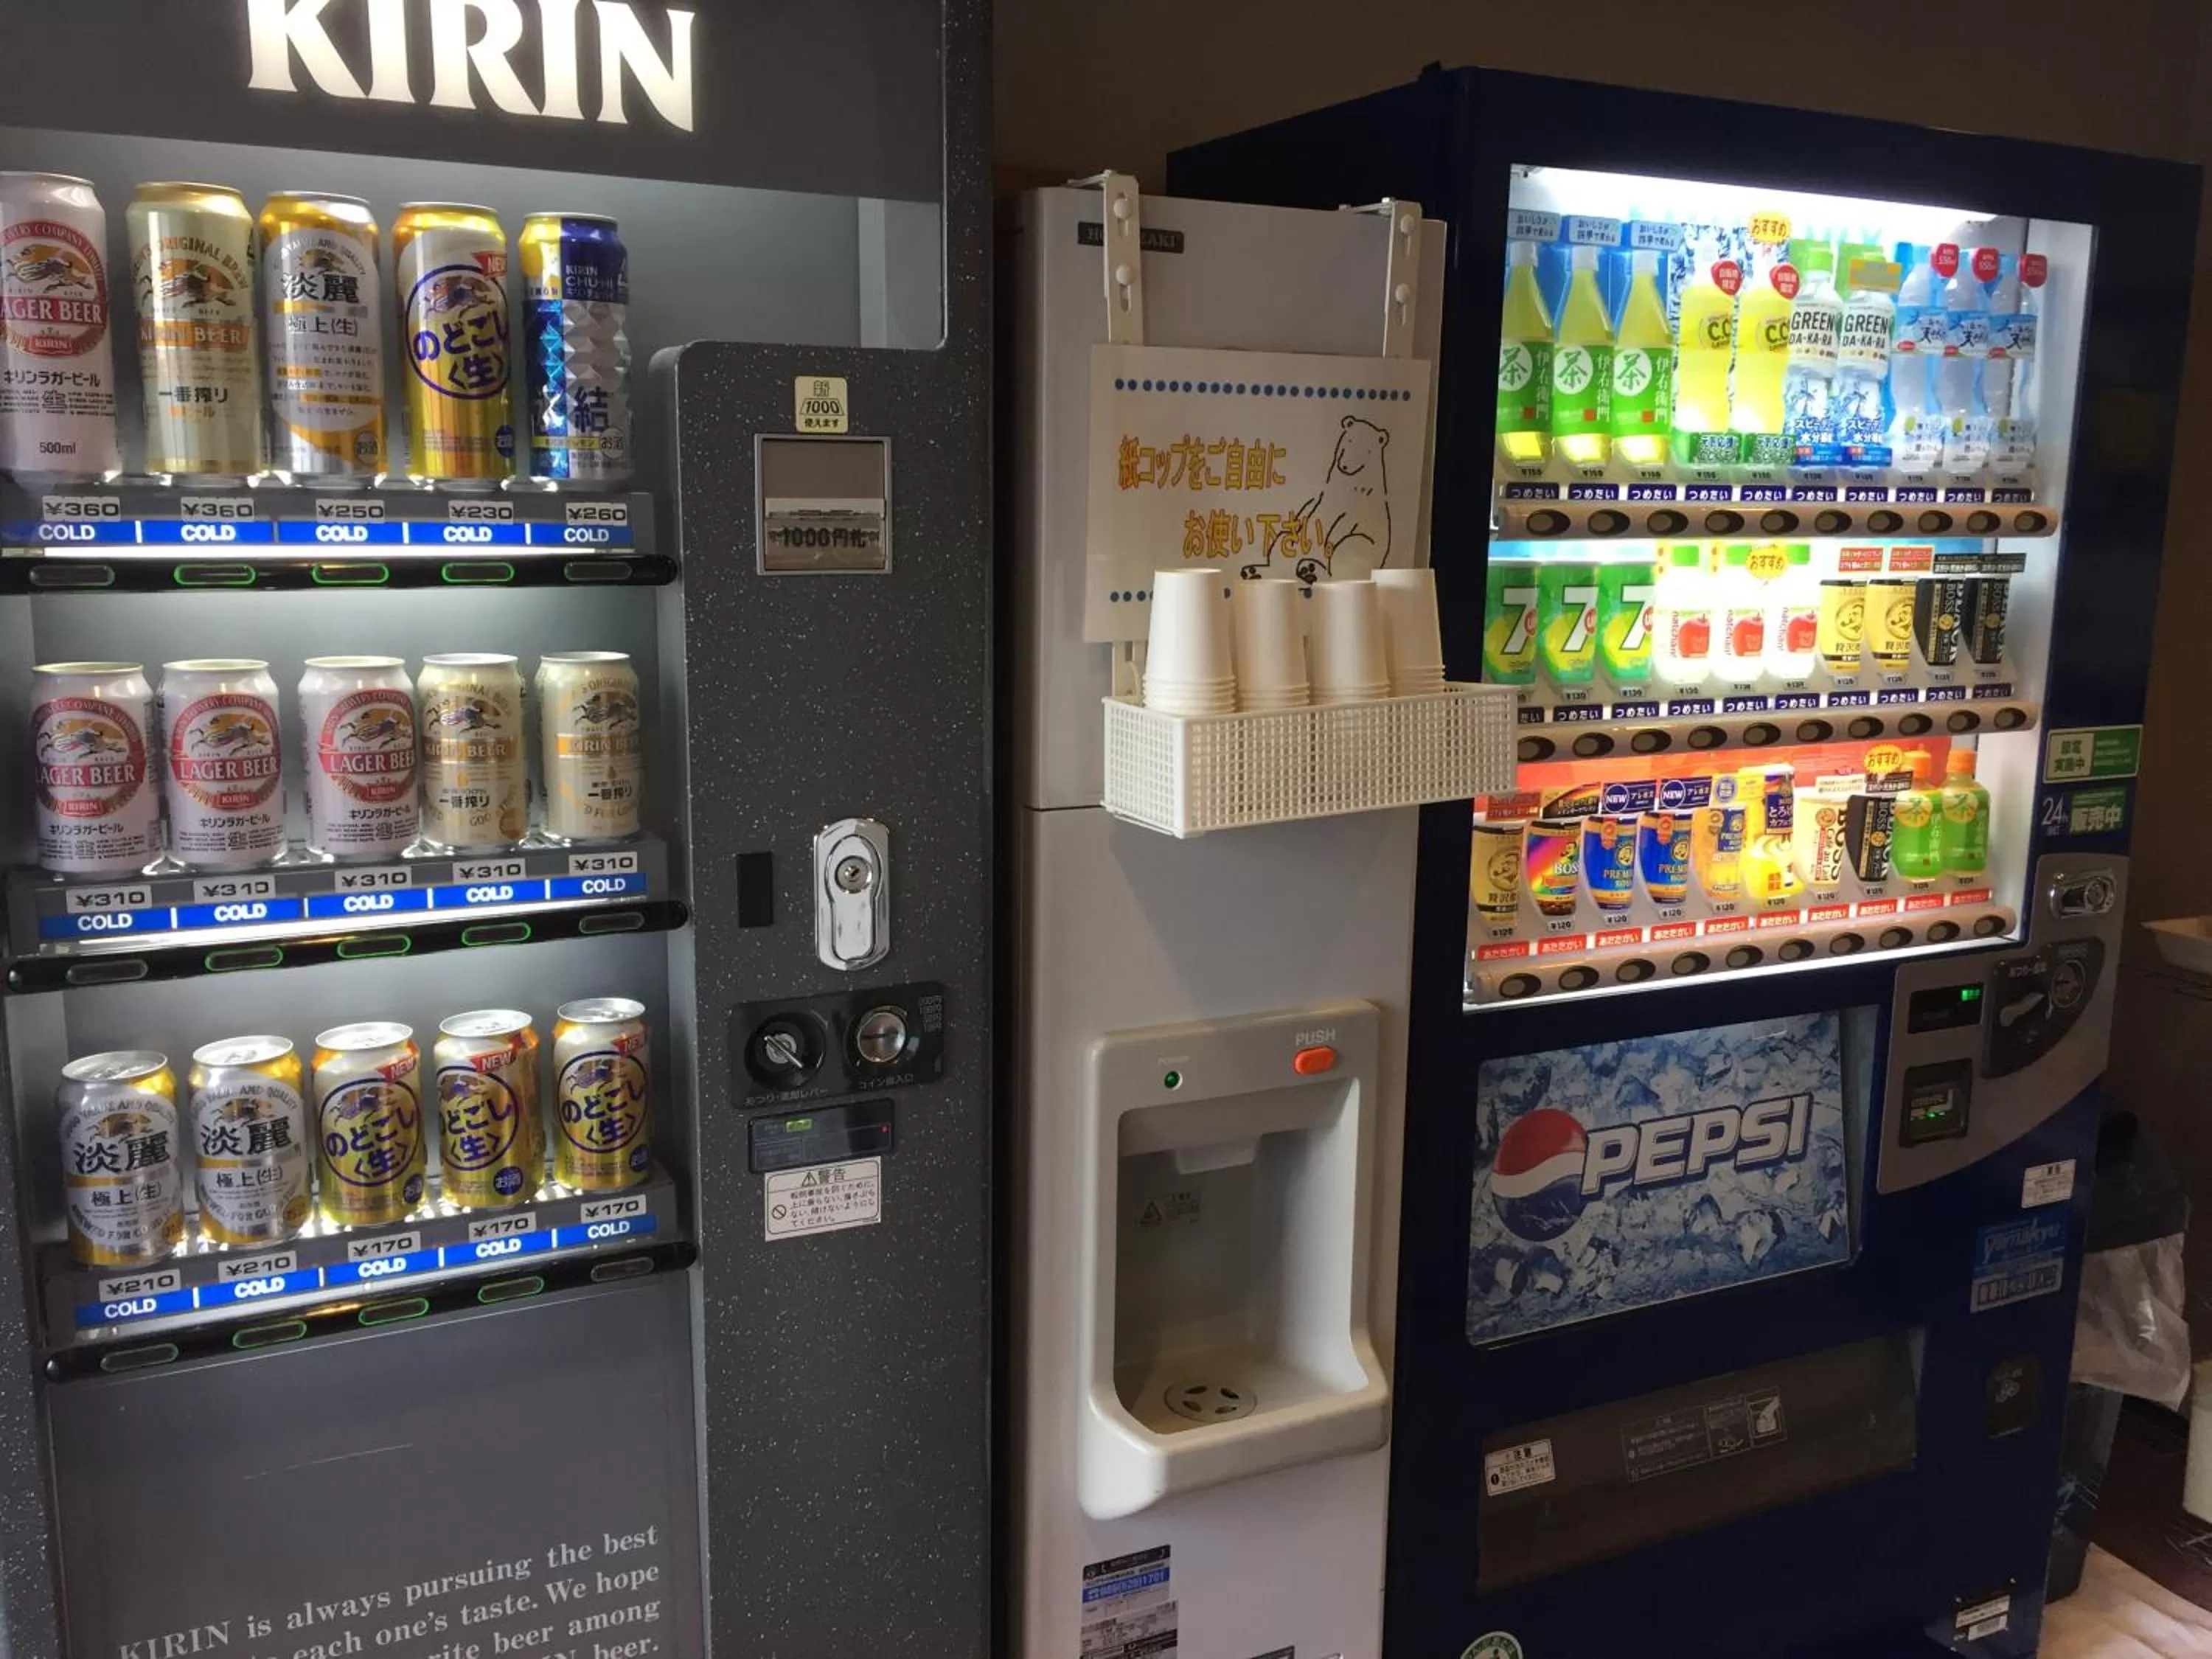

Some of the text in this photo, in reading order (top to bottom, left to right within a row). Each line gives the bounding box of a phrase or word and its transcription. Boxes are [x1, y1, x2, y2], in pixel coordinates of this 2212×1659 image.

[247, 0, 696, 133] KIRIN
[1752, 220, 1787, 236] おすすめ
[281, 272, 361, 304] 淡麗
[0, 298, 102, 324] AGER BEER
[1792, 310, 1834, 331] GREEN
[1845, 313, 1888, 334] GREEN
[195, 326, 241, 344] BEER
[1499, 347, 1528, 386] 茶
[1557, 349, 1588, 390] 茶
[1616, 352, 1647, 392] 茶
[4, 370, 100, 387] キリンラガービール
[159, 386, 229, 404] 一番搾り
[805, 400, 841, 414] 1000
[39, 442, 76, 455] 500ml
[1117, 434, 1287, 491] 紙コップをご自由に
[1512, 487, 1555, 498] つめたい
[1572, 488, 1615, 498] つめたい
[1632, 489, 1672, 499] つめたい
[1688, 490, 1729, 501] つめたい
[1744, 490, 1782, 501] つめたい
[1795, 491, 1834, 501] つめたい
[1848, 492, 1885, 501] つめたい
[1899, 492, 1935, 502] つめたい
[1948, 493, 1982, 502] つめたい
[44, 502, 119, 516] ¥360
[181, 504, 253, 518] ¥360
[318, 504, 385, 519] ¥250
[451, 506, 514, 521] ¥230
[568, 507, 627, 522] ¥260
[38, 524, 95, 540] COLD
[181, 524, 237, 542] COLD
[316, 525, 368, 543] COLD
[443, 526, 493, 543] COLD
[564, 527, 610, 543] COLD
[1749, 556, 1784, 571] おすすめ
[1500, 584, 1540, 655] 7
[1561, 584, 1599, 653] 7
[1619, 583, 1655, 651] 7
[1778, 698, 1816, 709] つめたい
[1832, 696, 1867, 706] つめたい
[1881, 694, 1916, 703] つめたい
[1928, 691, 1962, 700] つめたい
[1615, 707, 1655, 718] つめたい
[1672, 705, 1711, 715] つめたい
[1726, 701, 1764, 712] つめたい
[1557, 711, 1599, 720] つめたい
[179, 755, 279, 780] LAGER BEER
[331, 754, 387, 773] LAGER
[92, 764, 136, 784] BEER
[439, 795, 490, 810] 一番搾り
[1606, 795, 1627, 804] NEW
[1663, 790, 1684, 799] NEW
[48, 823, 125, 835] キリンラガービール
[200, 814, 271, 828] キリンラガービール
[459, 863, 522, 879] ¥310
[574, 856, 635, 871] ¥310
[341, 872, 408, 887] ¥310
[582, 877, 626, 894] COLD
[203, 882, 270, 897] ¥310
[465, 885, 513, 902] COLD
[76, 891, 145, 908] ¥310
[344, 894, 394, 912] COLD
[214, 902, 268, 922] COLD
[1607, 915, 1627, 923] ¥120
[1663, 909, 1682, 917] ¥120
[78, 913, 133, 931] COLD
[1551, 922, 1571, 930] ¥120
[1599, 933, 1640, 946] あたたかい
[1654, 927, 1694, 939] あたたかい
[1542, 940, 1584, 953] あたたかい
[1295, 1029, 1336, 1046] PUSH
[391, 1058, 416, 1079] NEW
[481, 1051, 514, 1070] NEW
[201, 1116, 292, 1157] 淡麗
[1580, 1092, 1814, 1197] PEPSI
[73, 1130, 171, 1175] 淡麗
[585, 1201, 639, 1220] ¥170
[472, 1218, 529, 1237] ¥170
[587, 1220, 630, 1239] COLD
[354, 1237, 412, 1259] ¥170
[476, 1238, 521, 1259] COLD
[226, 1256, 291, 1276] ¥210
[358, 1257, 407, 1278] COLD
[107, 1274, 174, 1295] ¥210
[234, 1276, 285, 1298] COLD
[105, 1298, 157, 1318] COLD
[118, 1524, 658, 1659] KIRIN is always pursuing the best
[293, 1630, 364, 1659] each
[461, 1593, 538, 1626] taste.
[545, 1579, 587, 1604] We
[596, 1565, 660, 1594] hope
[493, 1624, 554, 1655] beer
[568, 1600, 661, 1637] among
[594, 1636, 660, 1659] beer.
